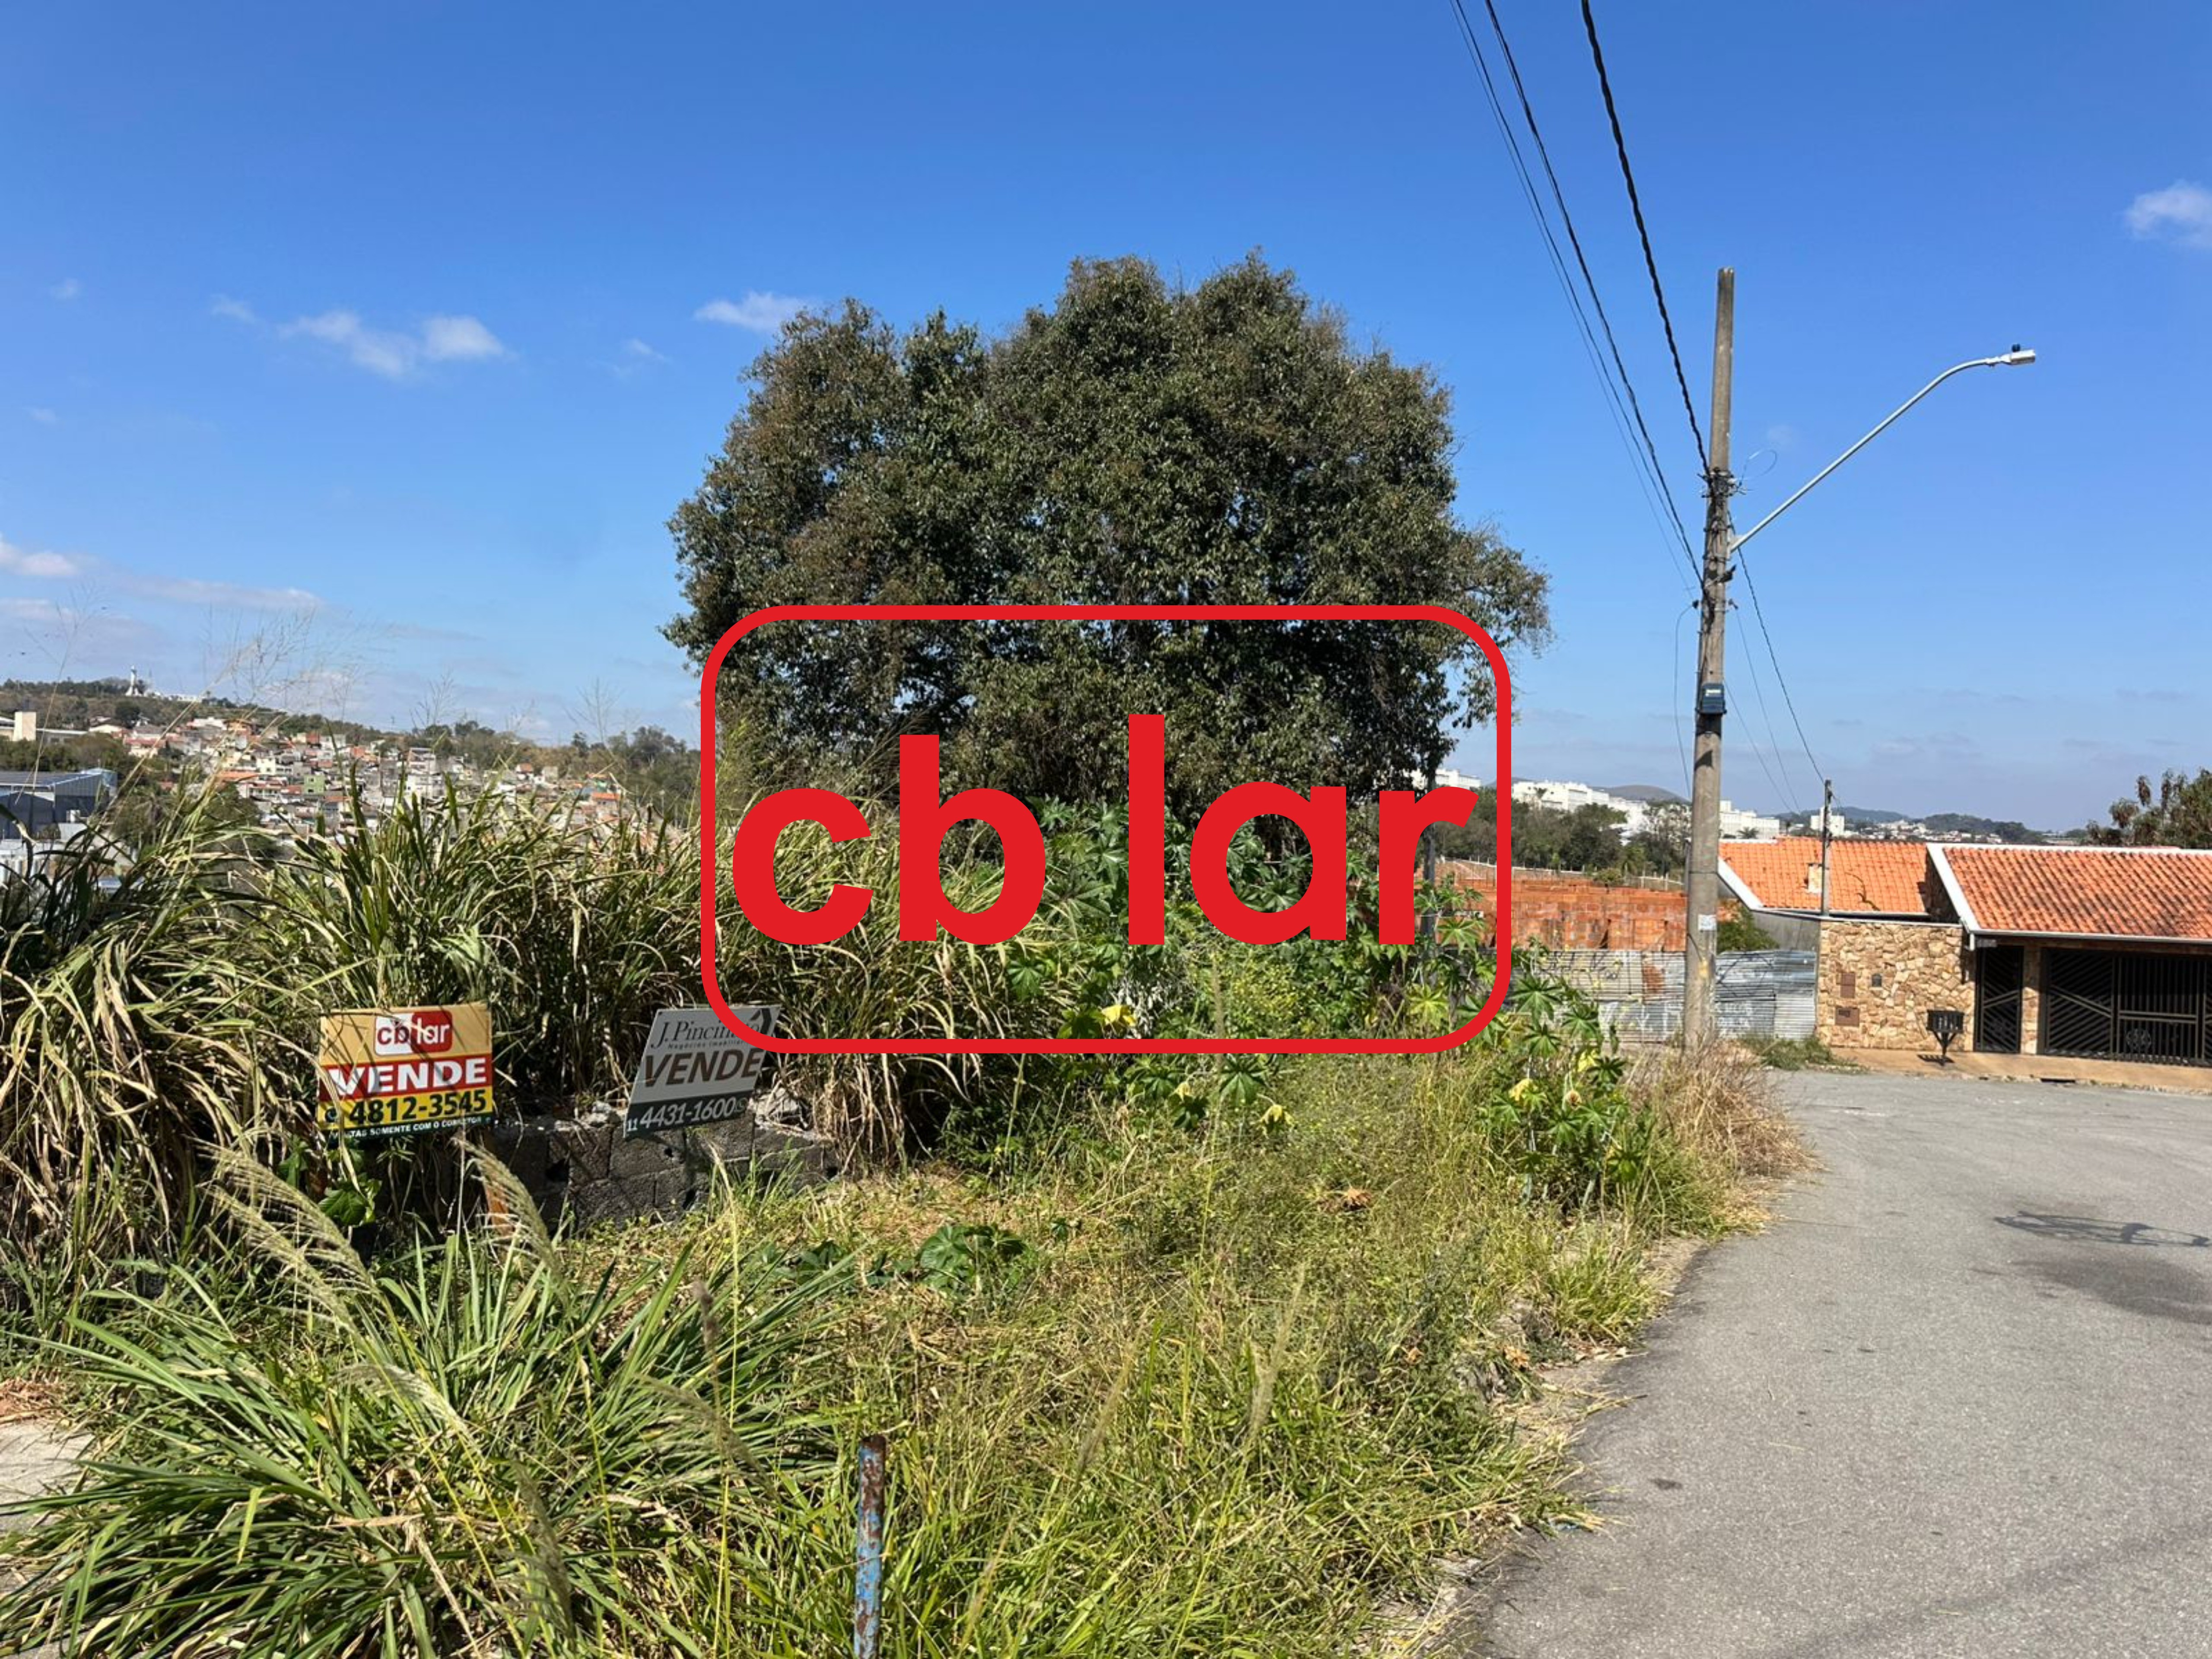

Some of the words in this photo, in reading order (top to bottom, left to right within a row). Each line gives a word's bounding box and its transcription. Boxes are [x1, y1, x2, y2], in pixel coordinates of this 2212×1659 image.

[328, 1057, 486, 1096] VENDE
[645, 1048, 765, 1087] VENDE
[349, 1090, 486, 1124] 4812-3545
[640, 1097, 734, 1129] 4431-1600
[370, 1125, 411, 1136] SOMENTE
[413, 1122, 431, 1131] COM
